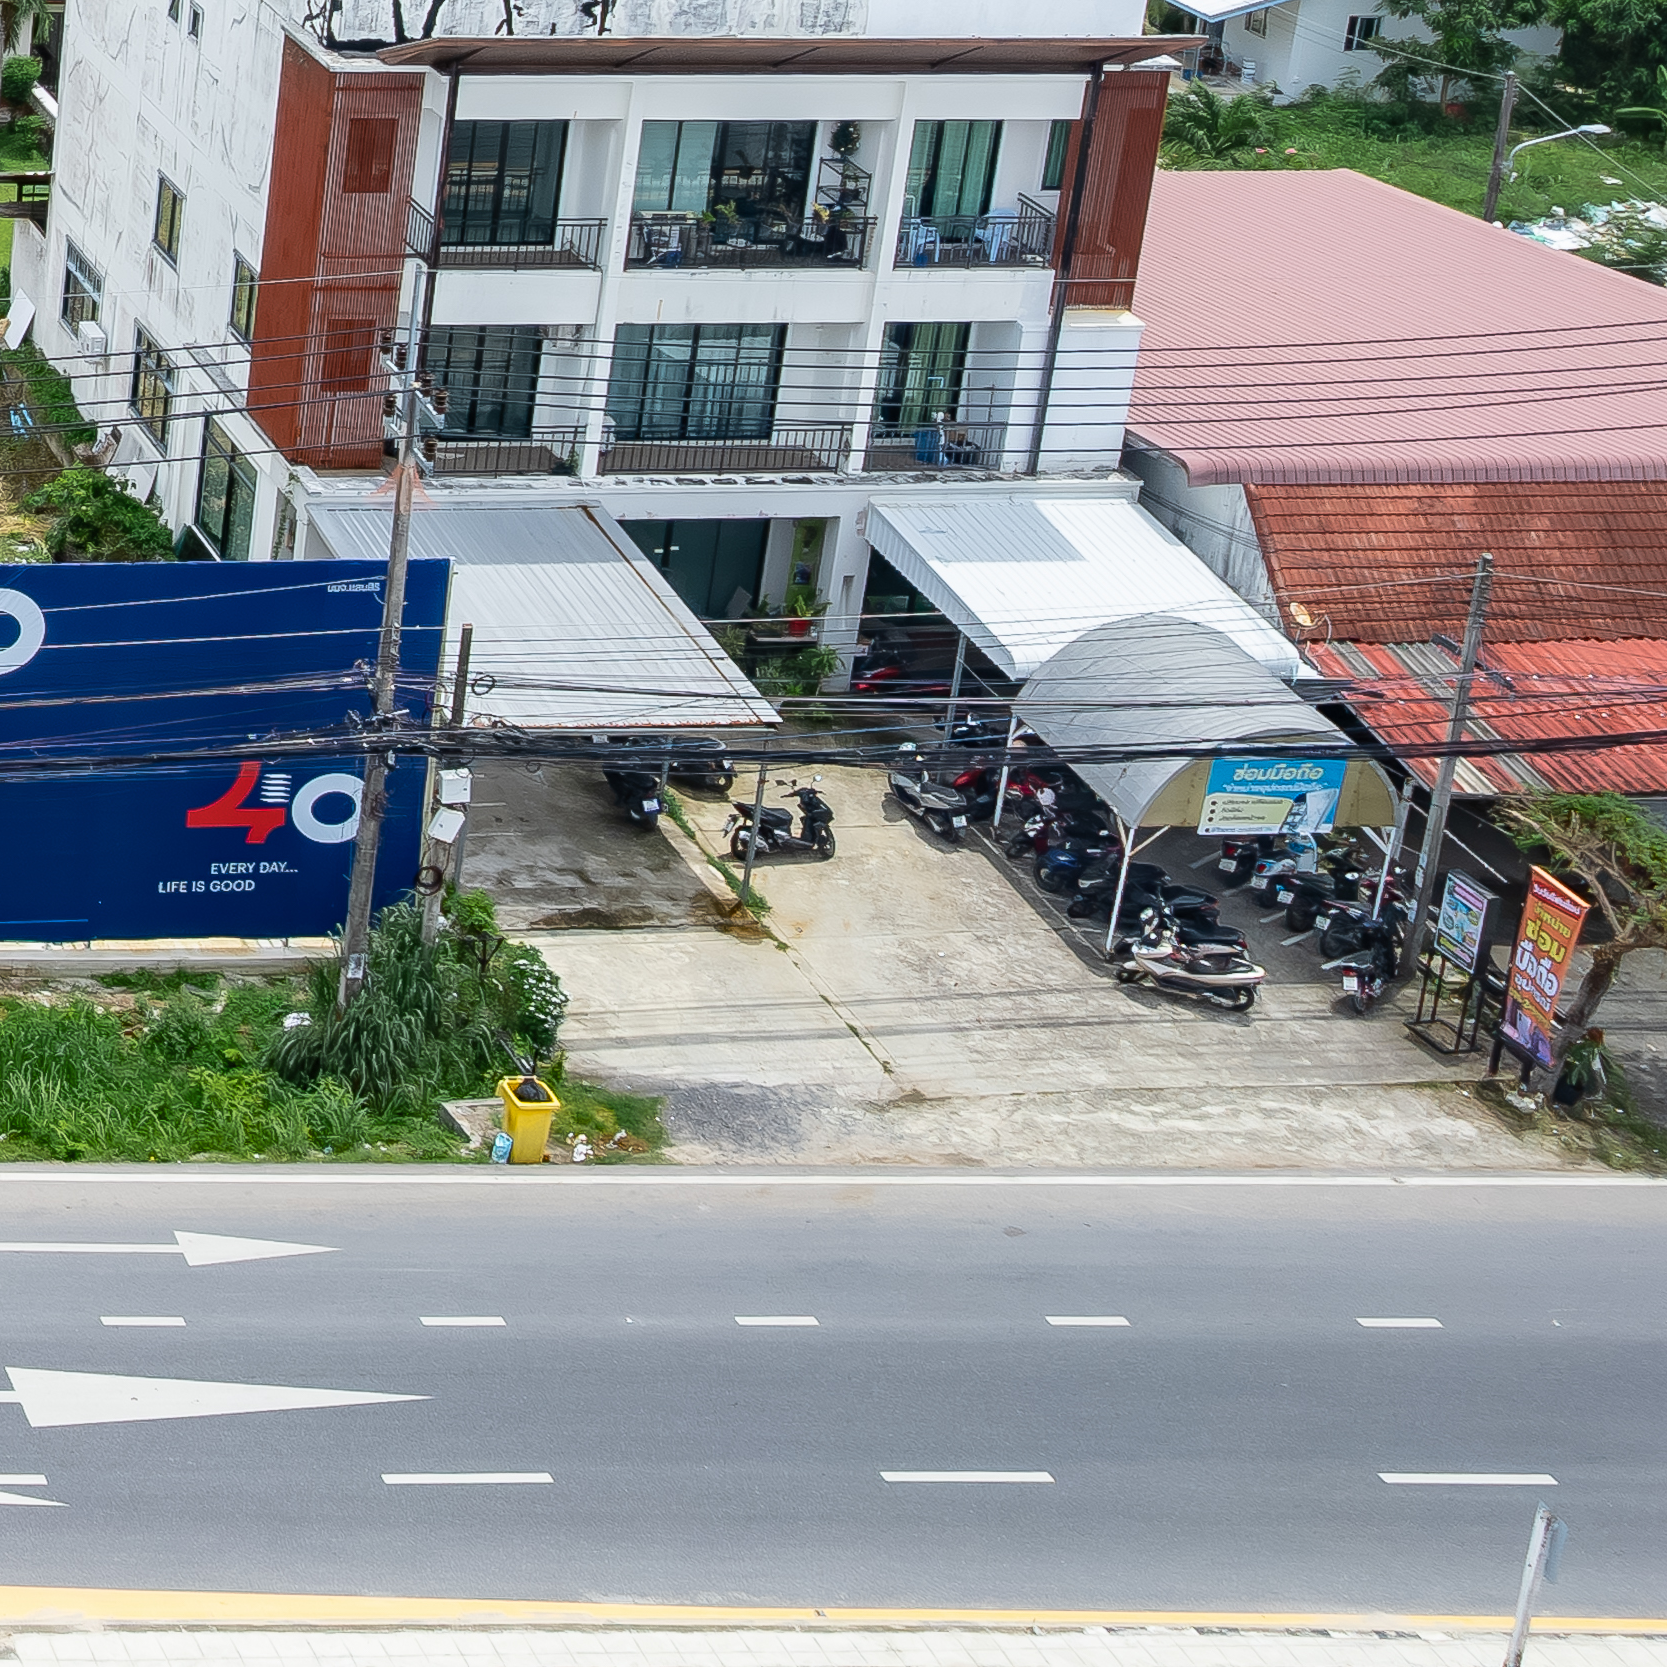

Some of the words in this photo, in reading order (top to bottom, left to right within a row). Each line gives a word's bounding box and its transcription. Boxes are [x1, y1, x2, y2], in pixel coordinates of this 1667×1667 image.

[1232, 763, 1324, 780] ซ่อมมือถือ
[211, 862, 256, 874] EVERY
[158, 881, 188, 893] LIFE
[192, 881, 205, 892] IS
[210, 880, 255, 892] GOOD
[1525, 918, 1566, 964] ซ่อม
